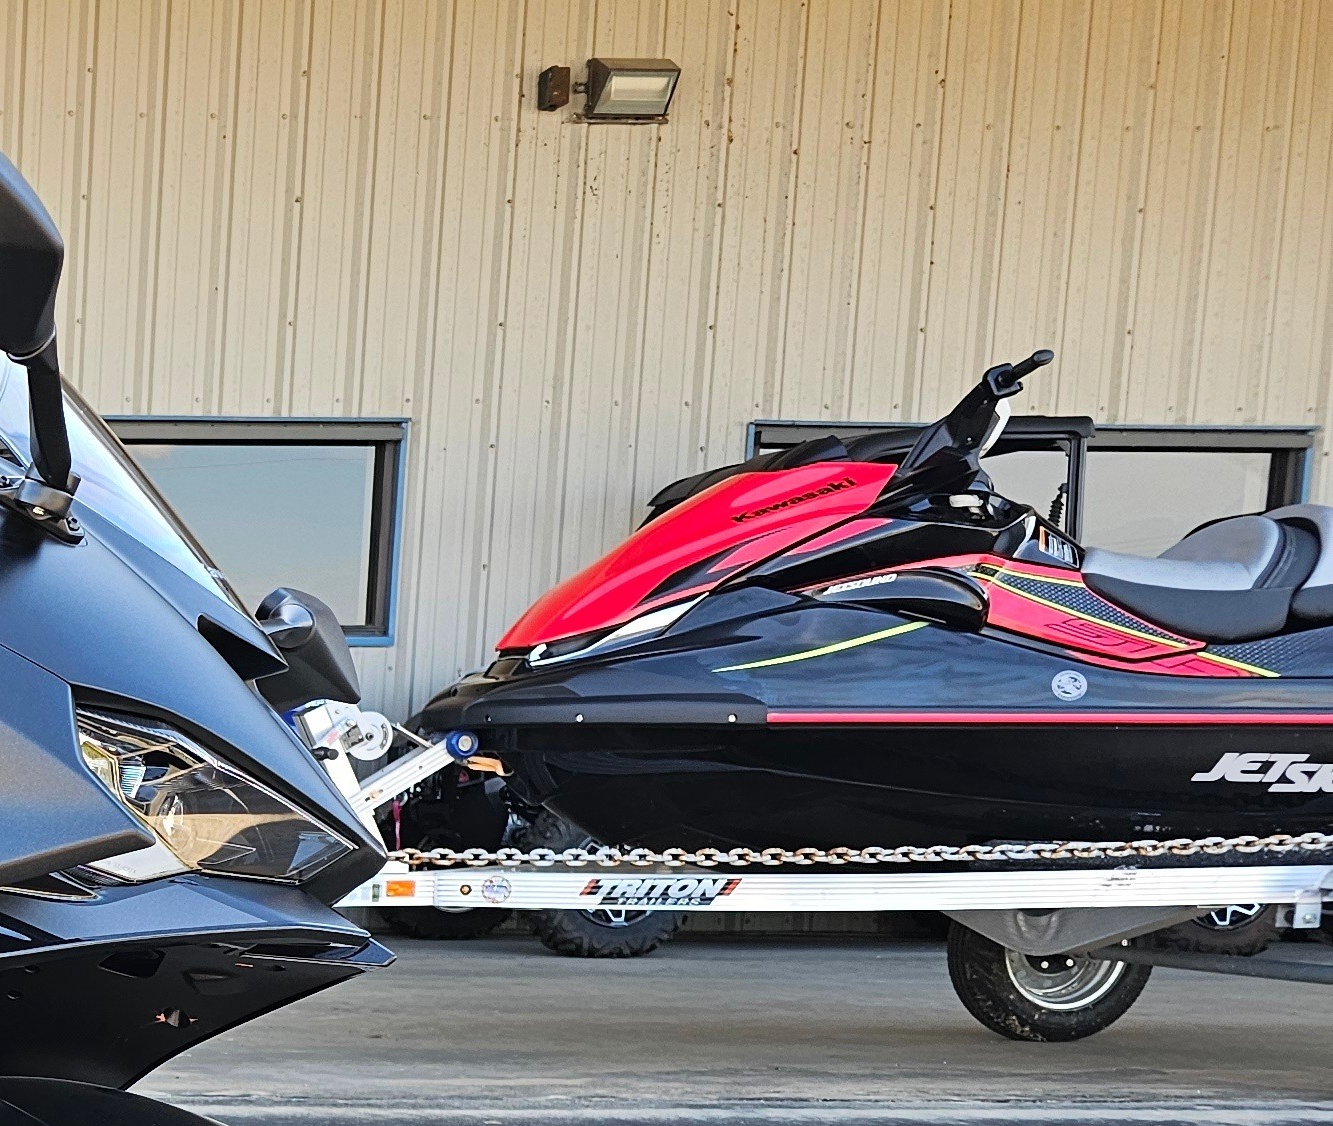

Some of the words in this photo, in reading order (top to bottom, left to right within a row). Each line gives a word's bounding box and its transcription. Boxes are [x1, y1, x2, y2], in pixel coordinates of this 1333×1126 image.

[731, 477, 858, 523] Kawasaki
[595, 878, 728, 898] TRITON
[616, 897, 702, 906] TRAILERS
